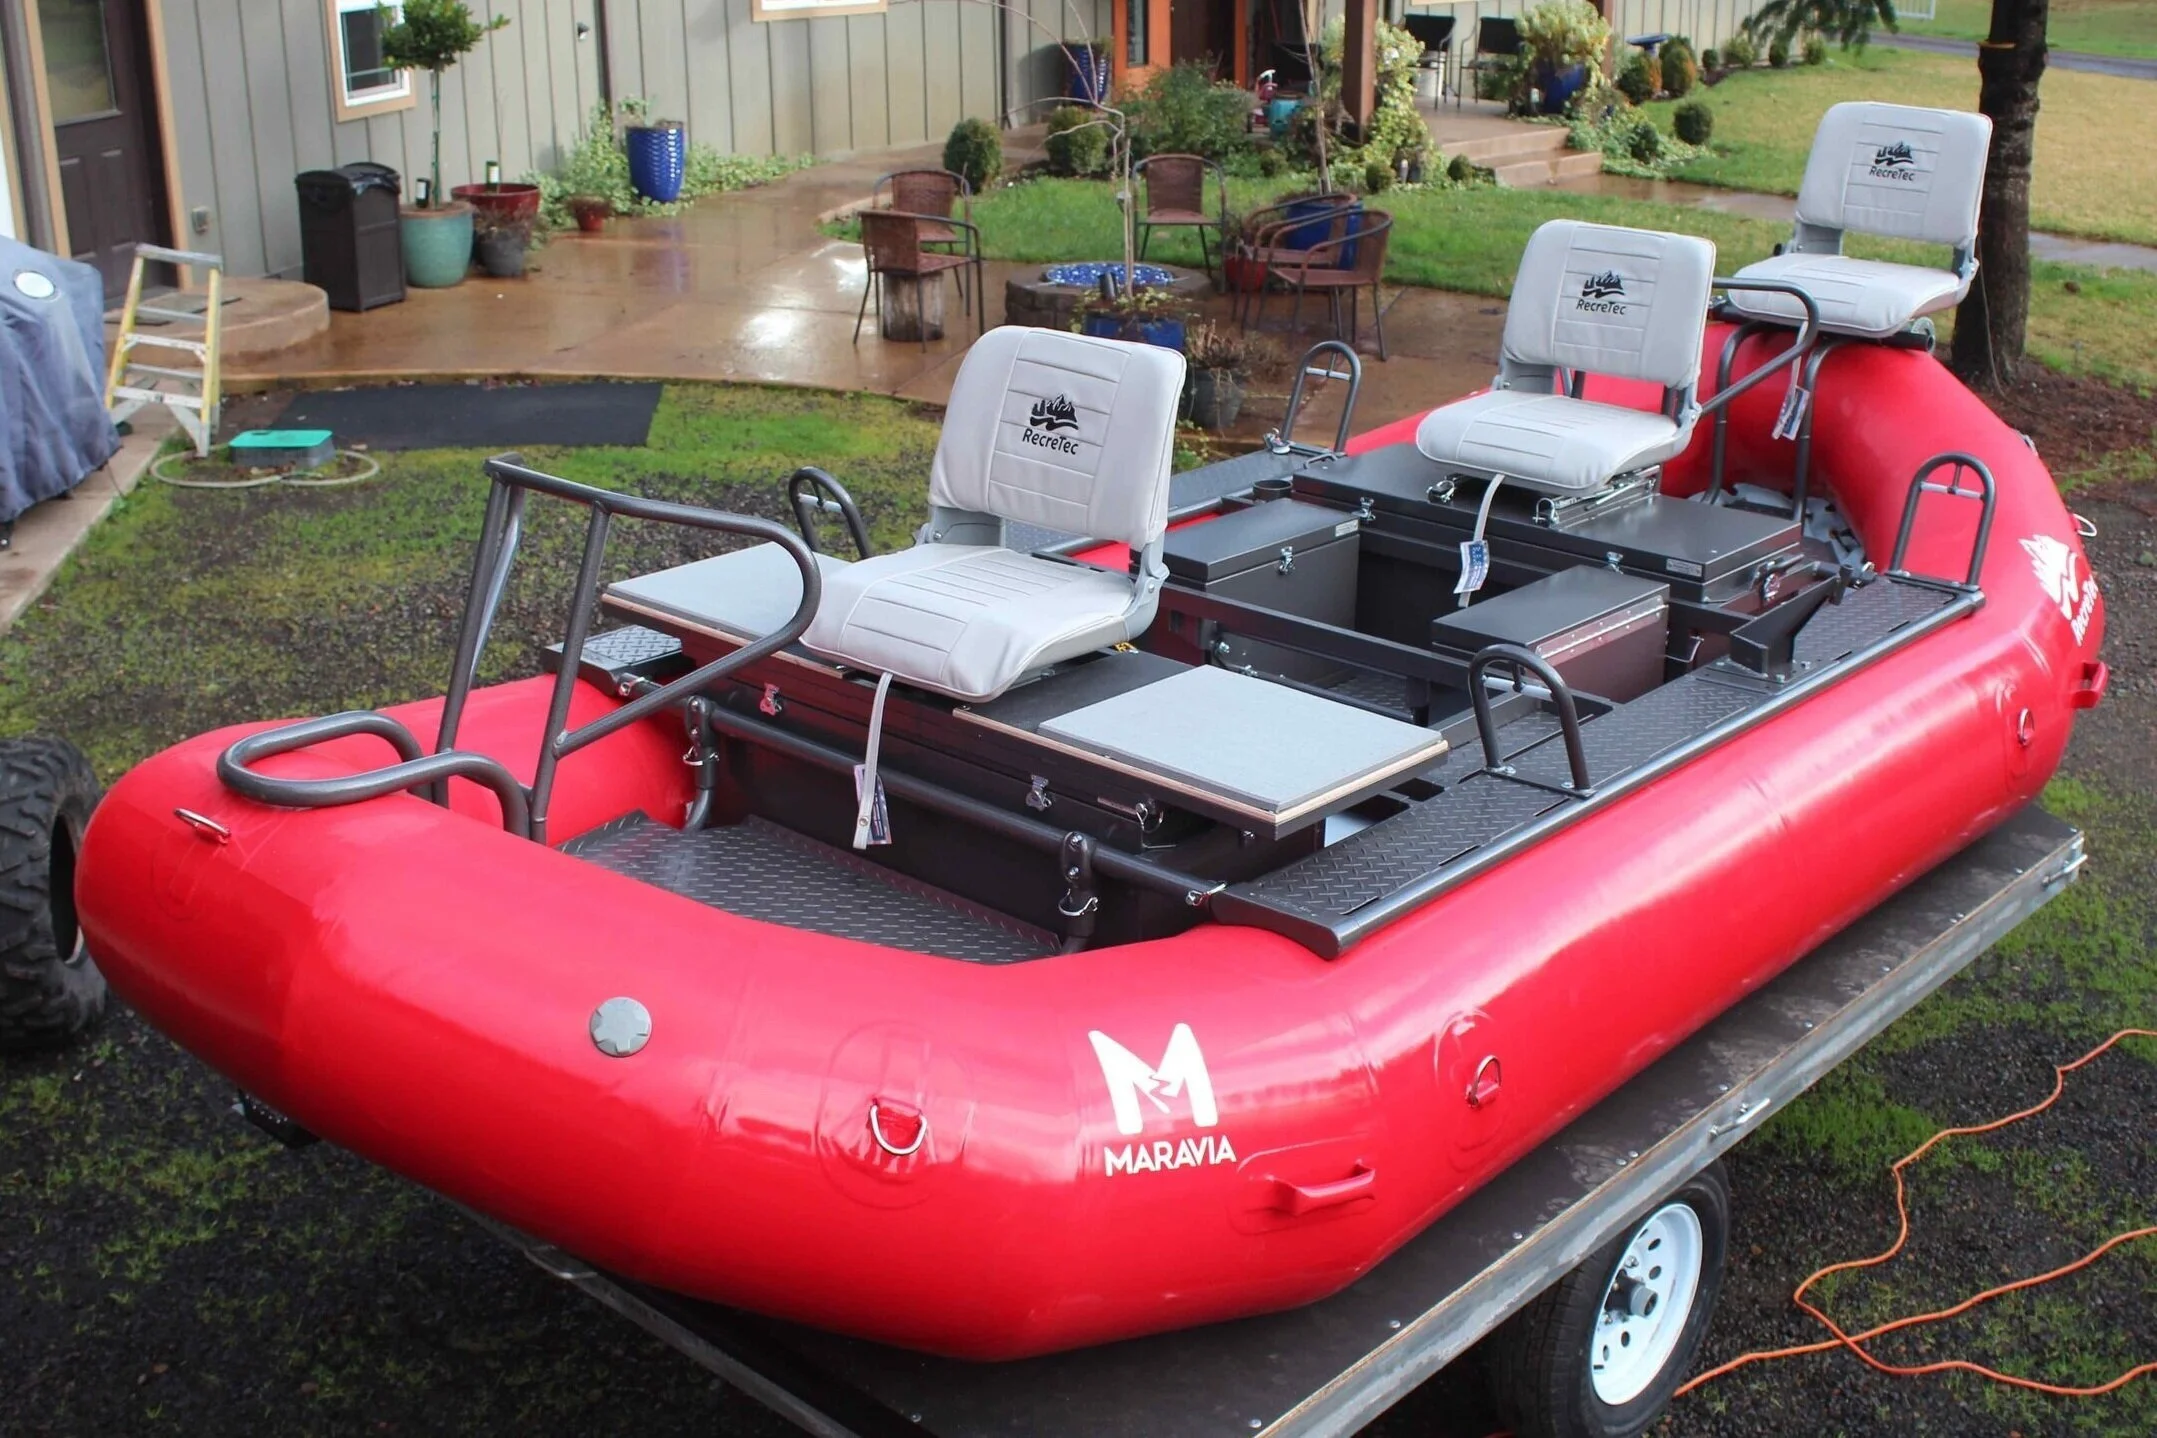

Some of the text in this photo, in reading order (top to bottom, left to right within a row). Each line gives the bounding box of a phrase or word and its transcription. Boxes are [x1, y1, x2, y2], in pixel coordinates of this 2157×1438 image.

[1869, 165, 1916, 182] RecreTec
[1575, 298, 1627, 316] RecreTec
[1022, 427, 1079, 456] RecreTec
[1103, 1134, 1237, 1178] MARAVIA
